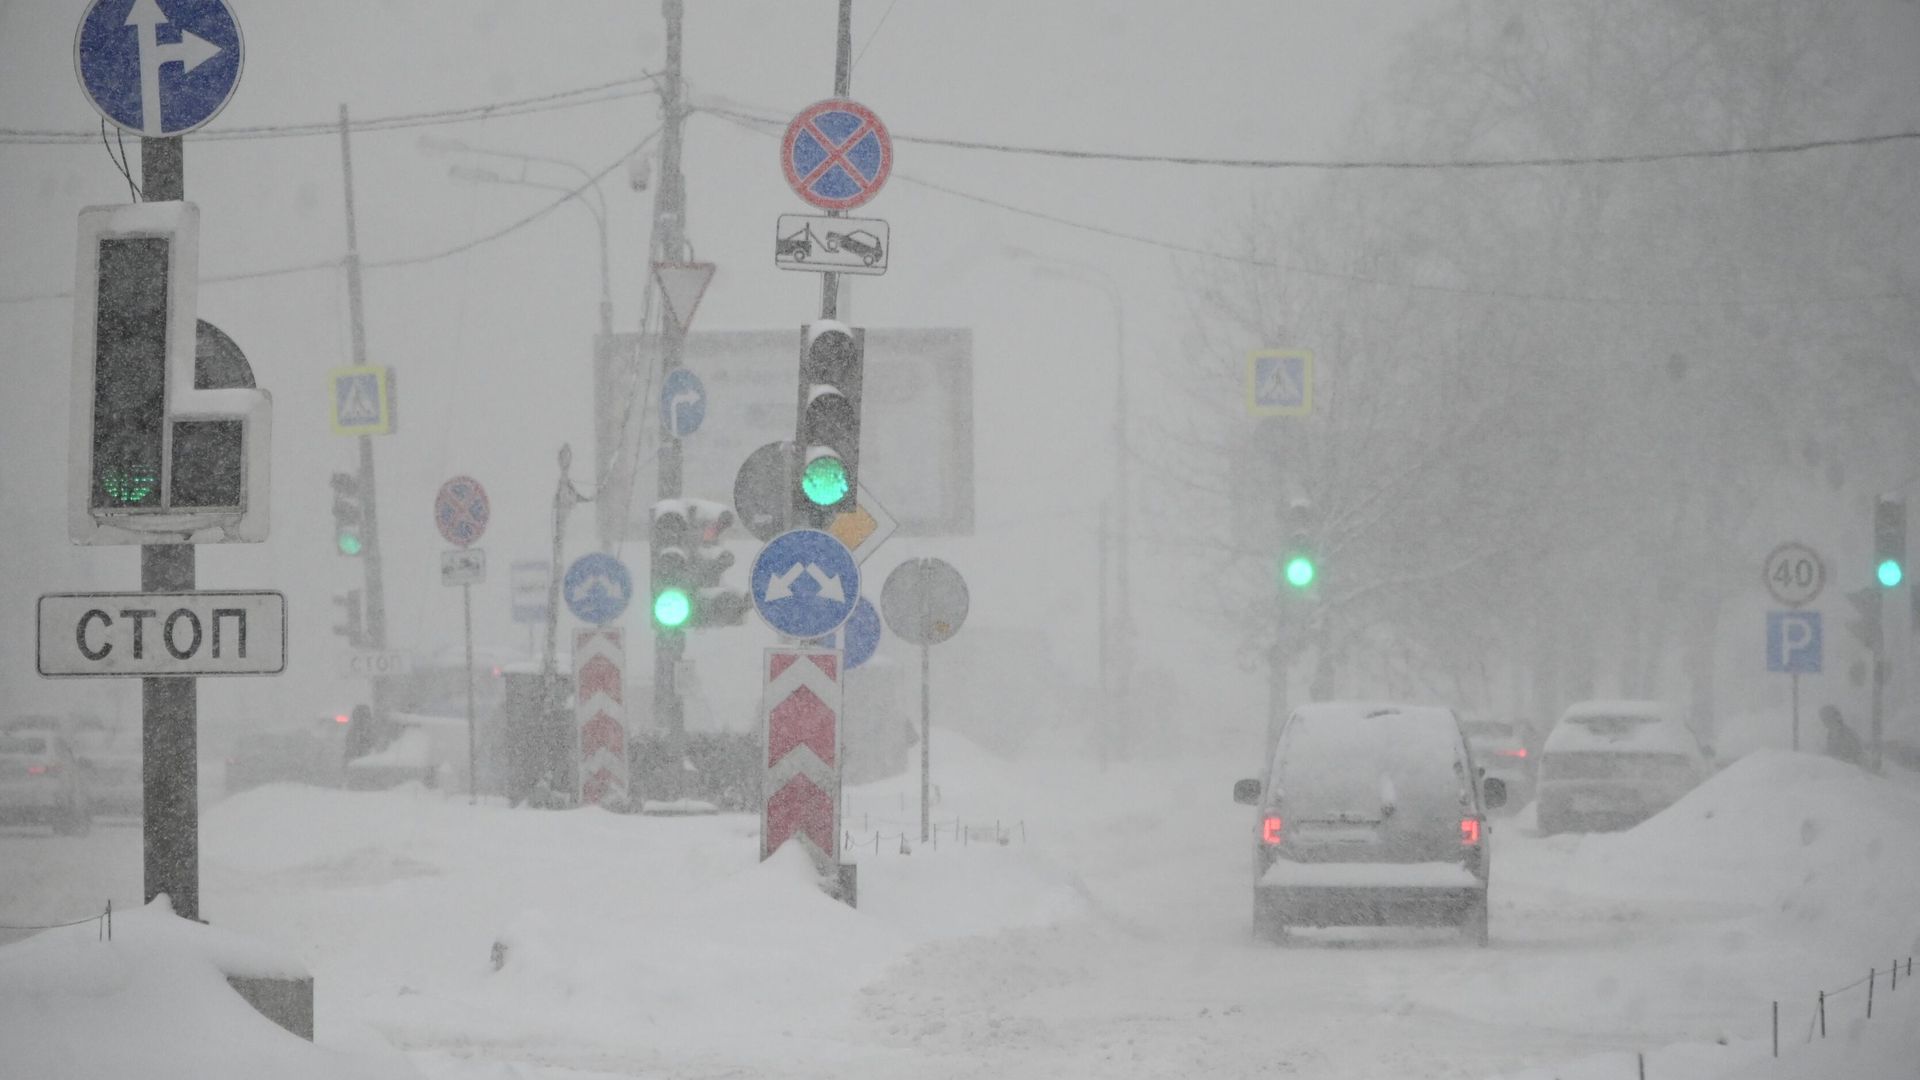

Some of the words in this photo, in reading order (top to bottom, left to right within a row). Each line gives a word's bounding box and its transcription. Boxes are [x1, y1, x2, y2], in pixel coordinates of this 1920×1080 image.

[1773, 559, 1813, 587] 40
[76, 608, 247, 661] СТОП
[1782, 618, 1811, 665] P
